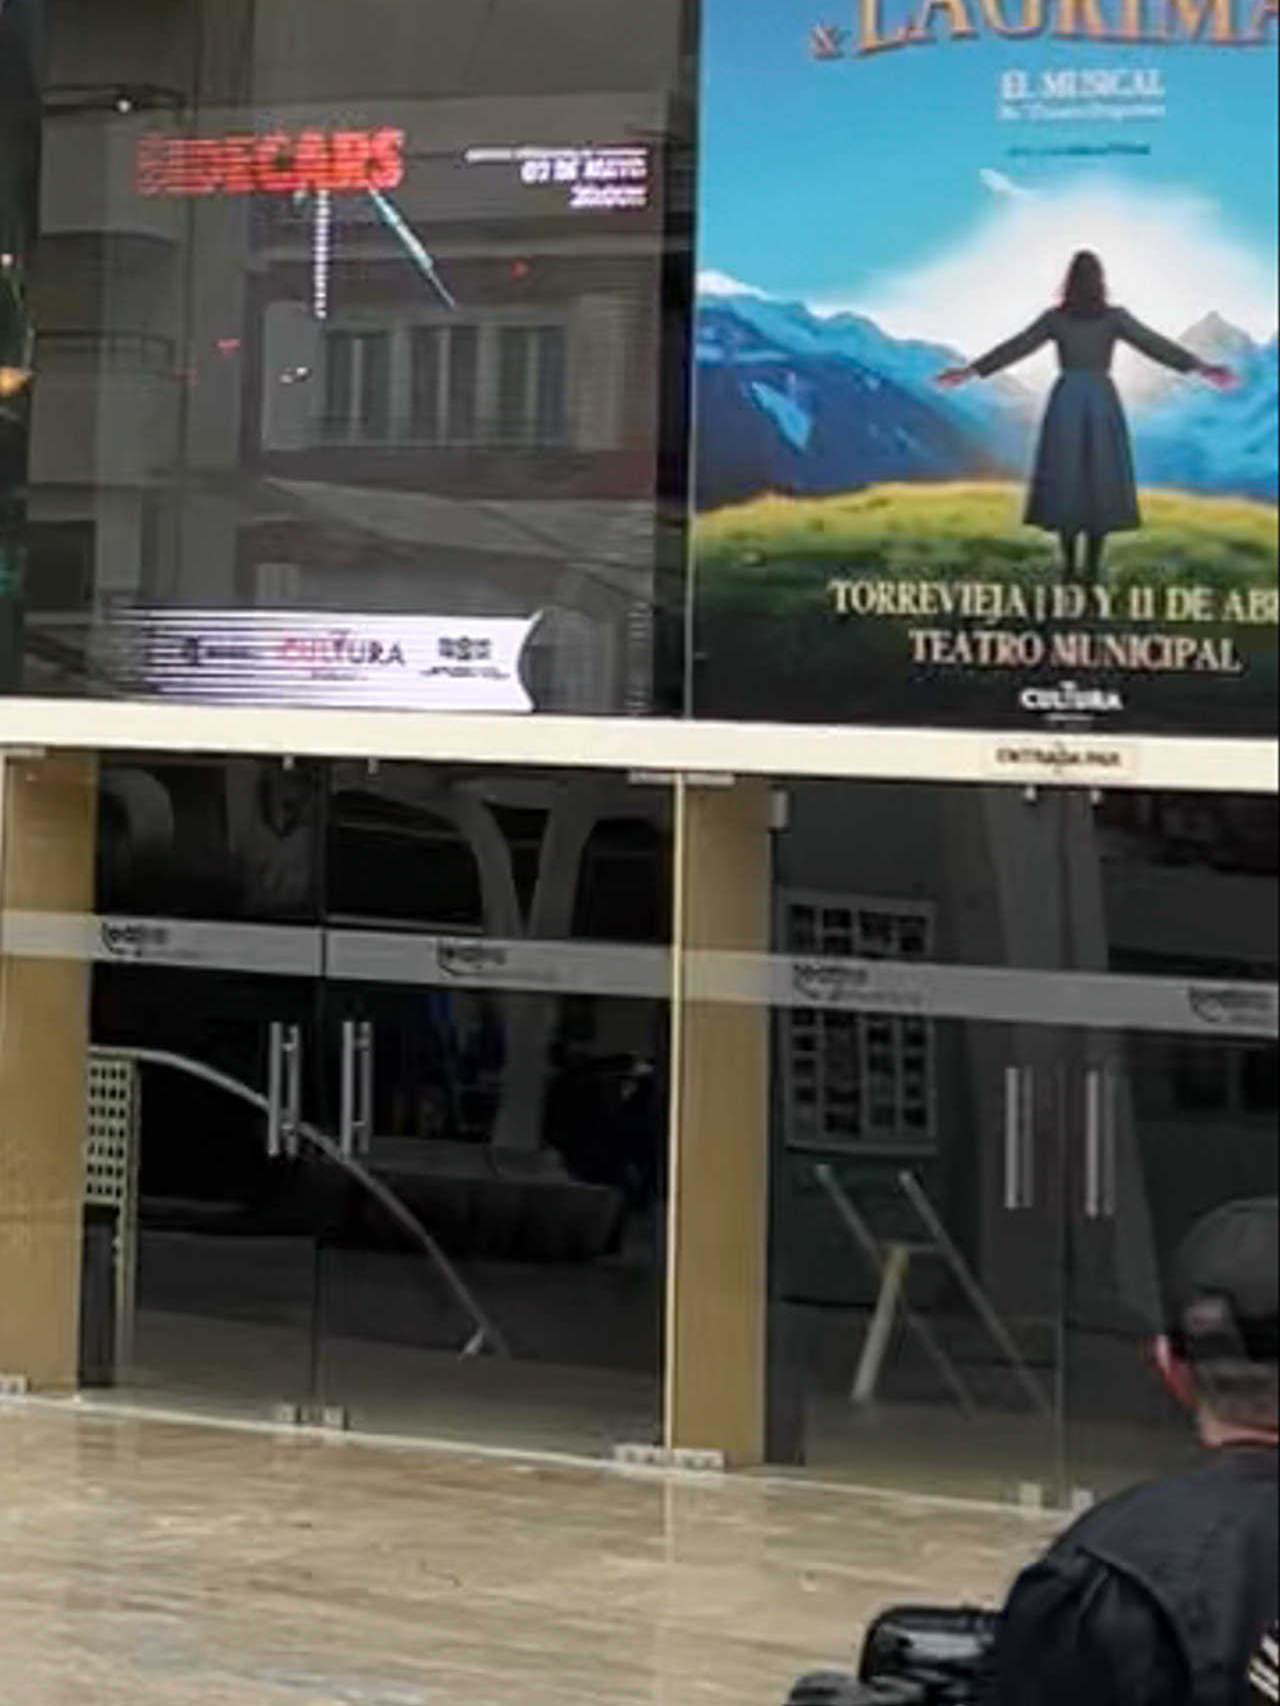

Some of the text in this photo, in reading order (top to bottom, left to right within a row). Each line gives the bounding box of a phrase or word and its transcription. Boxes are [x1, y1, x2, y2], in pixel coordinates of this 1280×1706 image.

[1041, 68, 1166, 99] MUSICAL
[827, 578, 1028, 625] TORREVIEJA
[1091, 584, 1114, 619] Y
[1165, 587, 1215, 623] DE
[278, 631, 407, 667] CULTURA
[908, 629, 1243, 672] TEATRO MUNICIPAL
